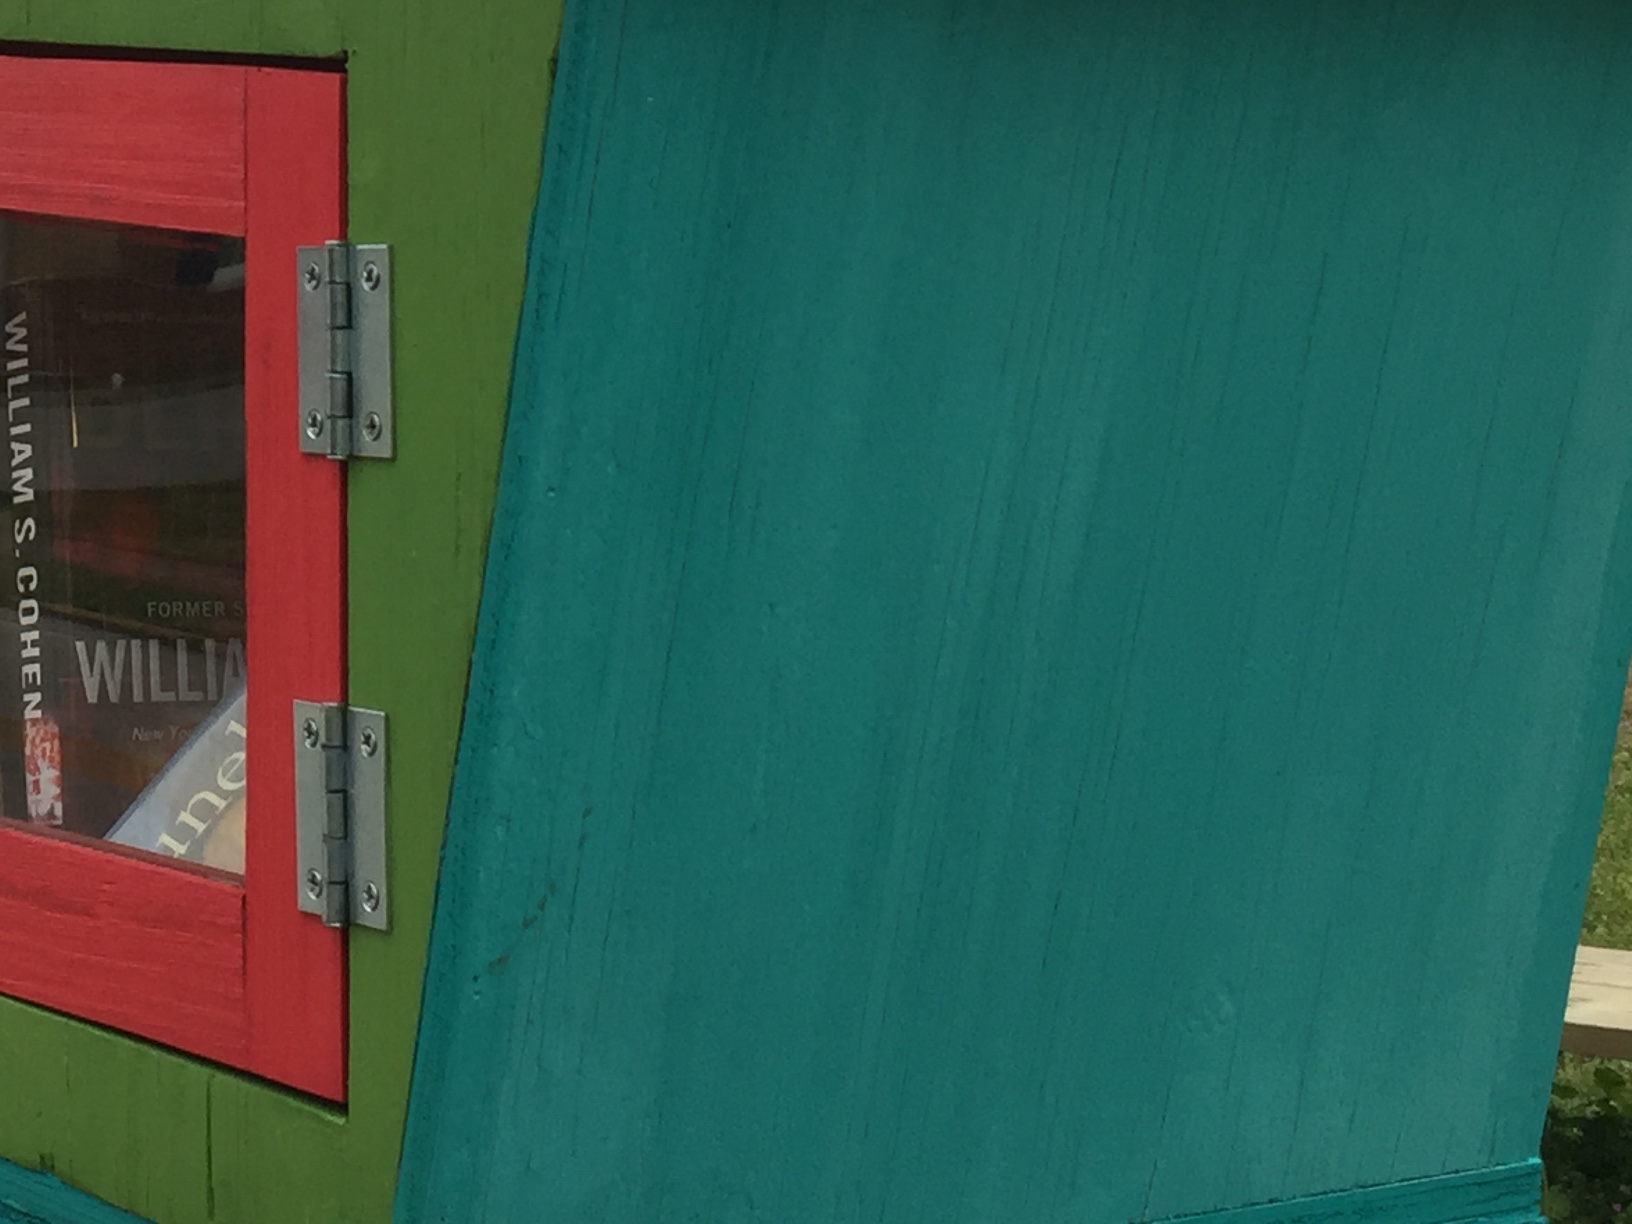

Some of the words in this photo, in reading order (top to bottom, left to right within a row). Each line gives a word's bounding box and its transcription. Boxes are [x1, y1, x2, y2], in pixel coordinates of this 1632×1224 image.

[4, 310, 36, 505] WILLIAM
[13, 516, 37, 557] S.
[146, 600, 226, 618] FORMER
[15, 565, 43, 720] COHEN
[131, 726, 164, 742] New
